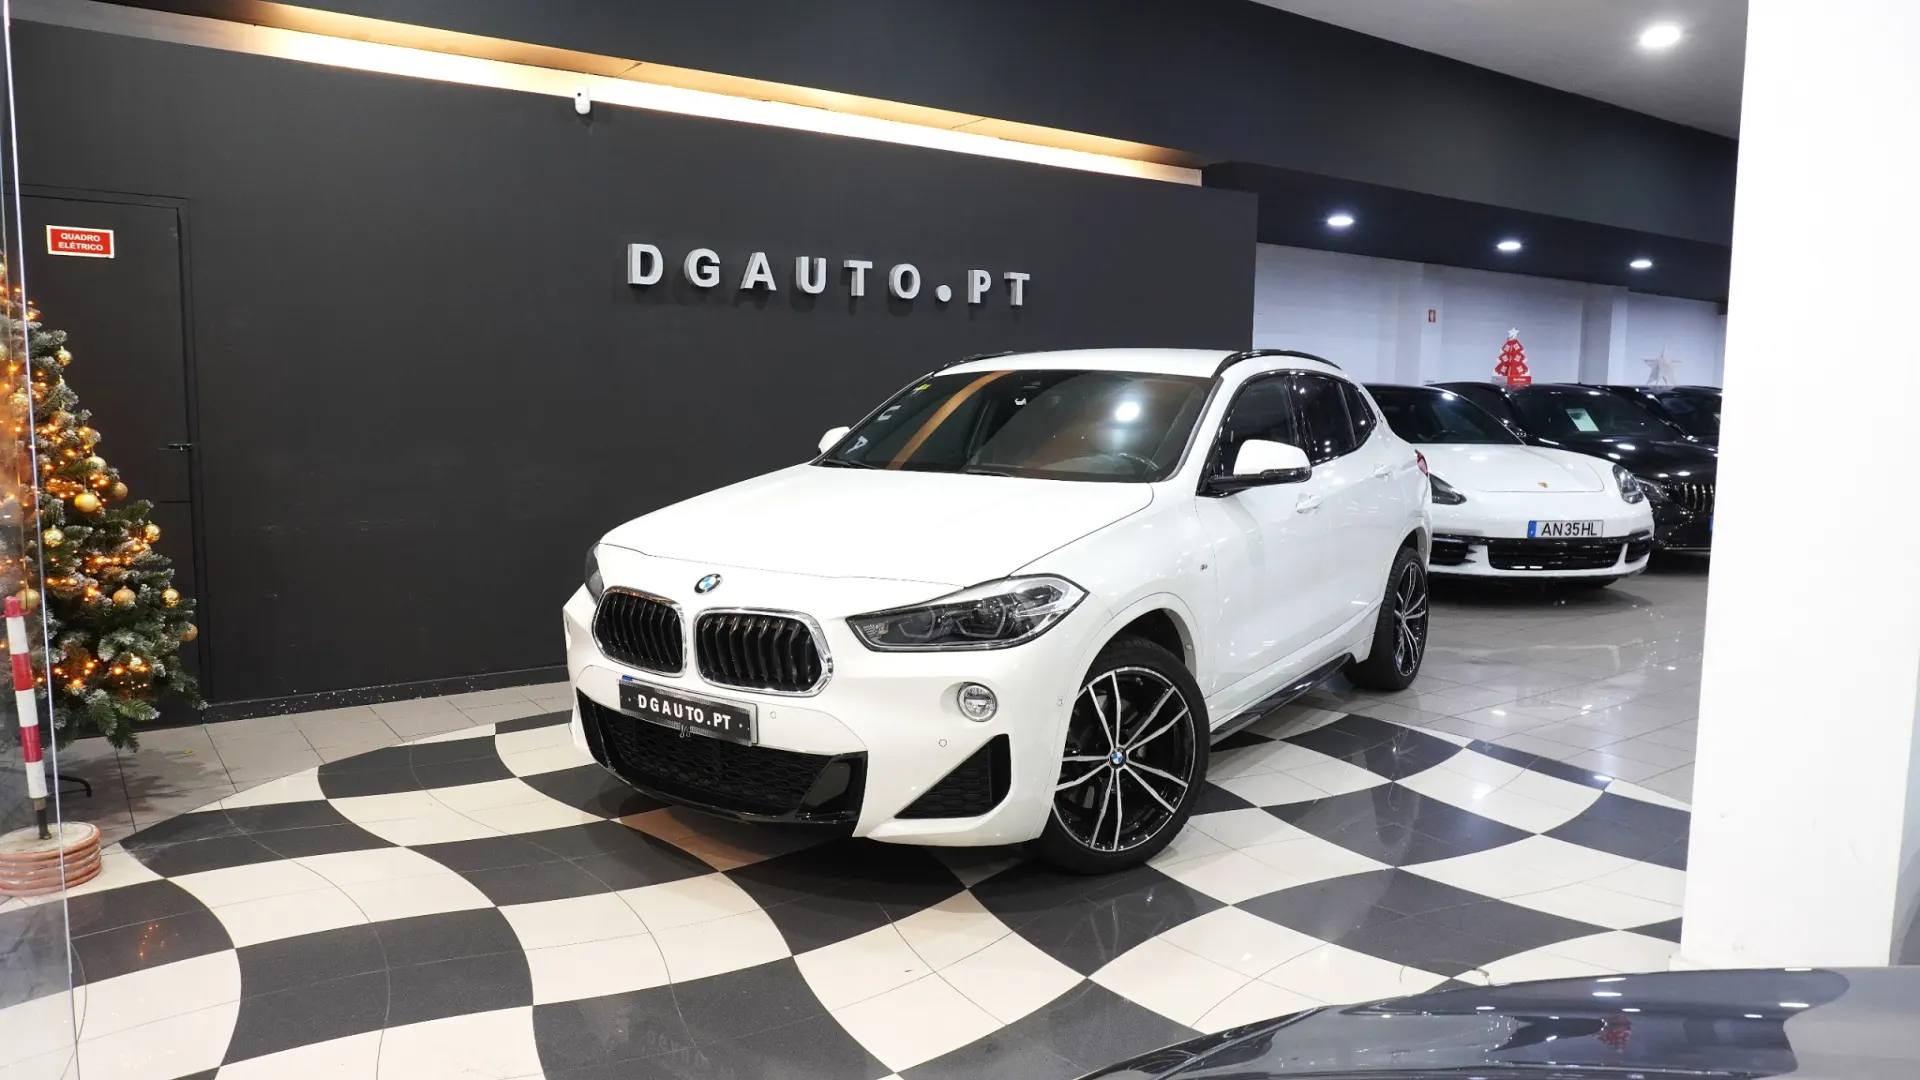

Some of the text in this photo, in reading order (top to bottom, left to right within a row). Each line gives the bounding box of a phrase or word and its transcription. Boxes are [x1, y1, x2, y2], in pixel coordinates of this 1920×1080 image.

[58, 241, 104, 251] ELÉTRICO
[60, 232, 101, 242] QUADRO
[627, 243, 1030, 306] DGAUTO.PT
[637, 694, 731, 730] DGAUTO.PT
